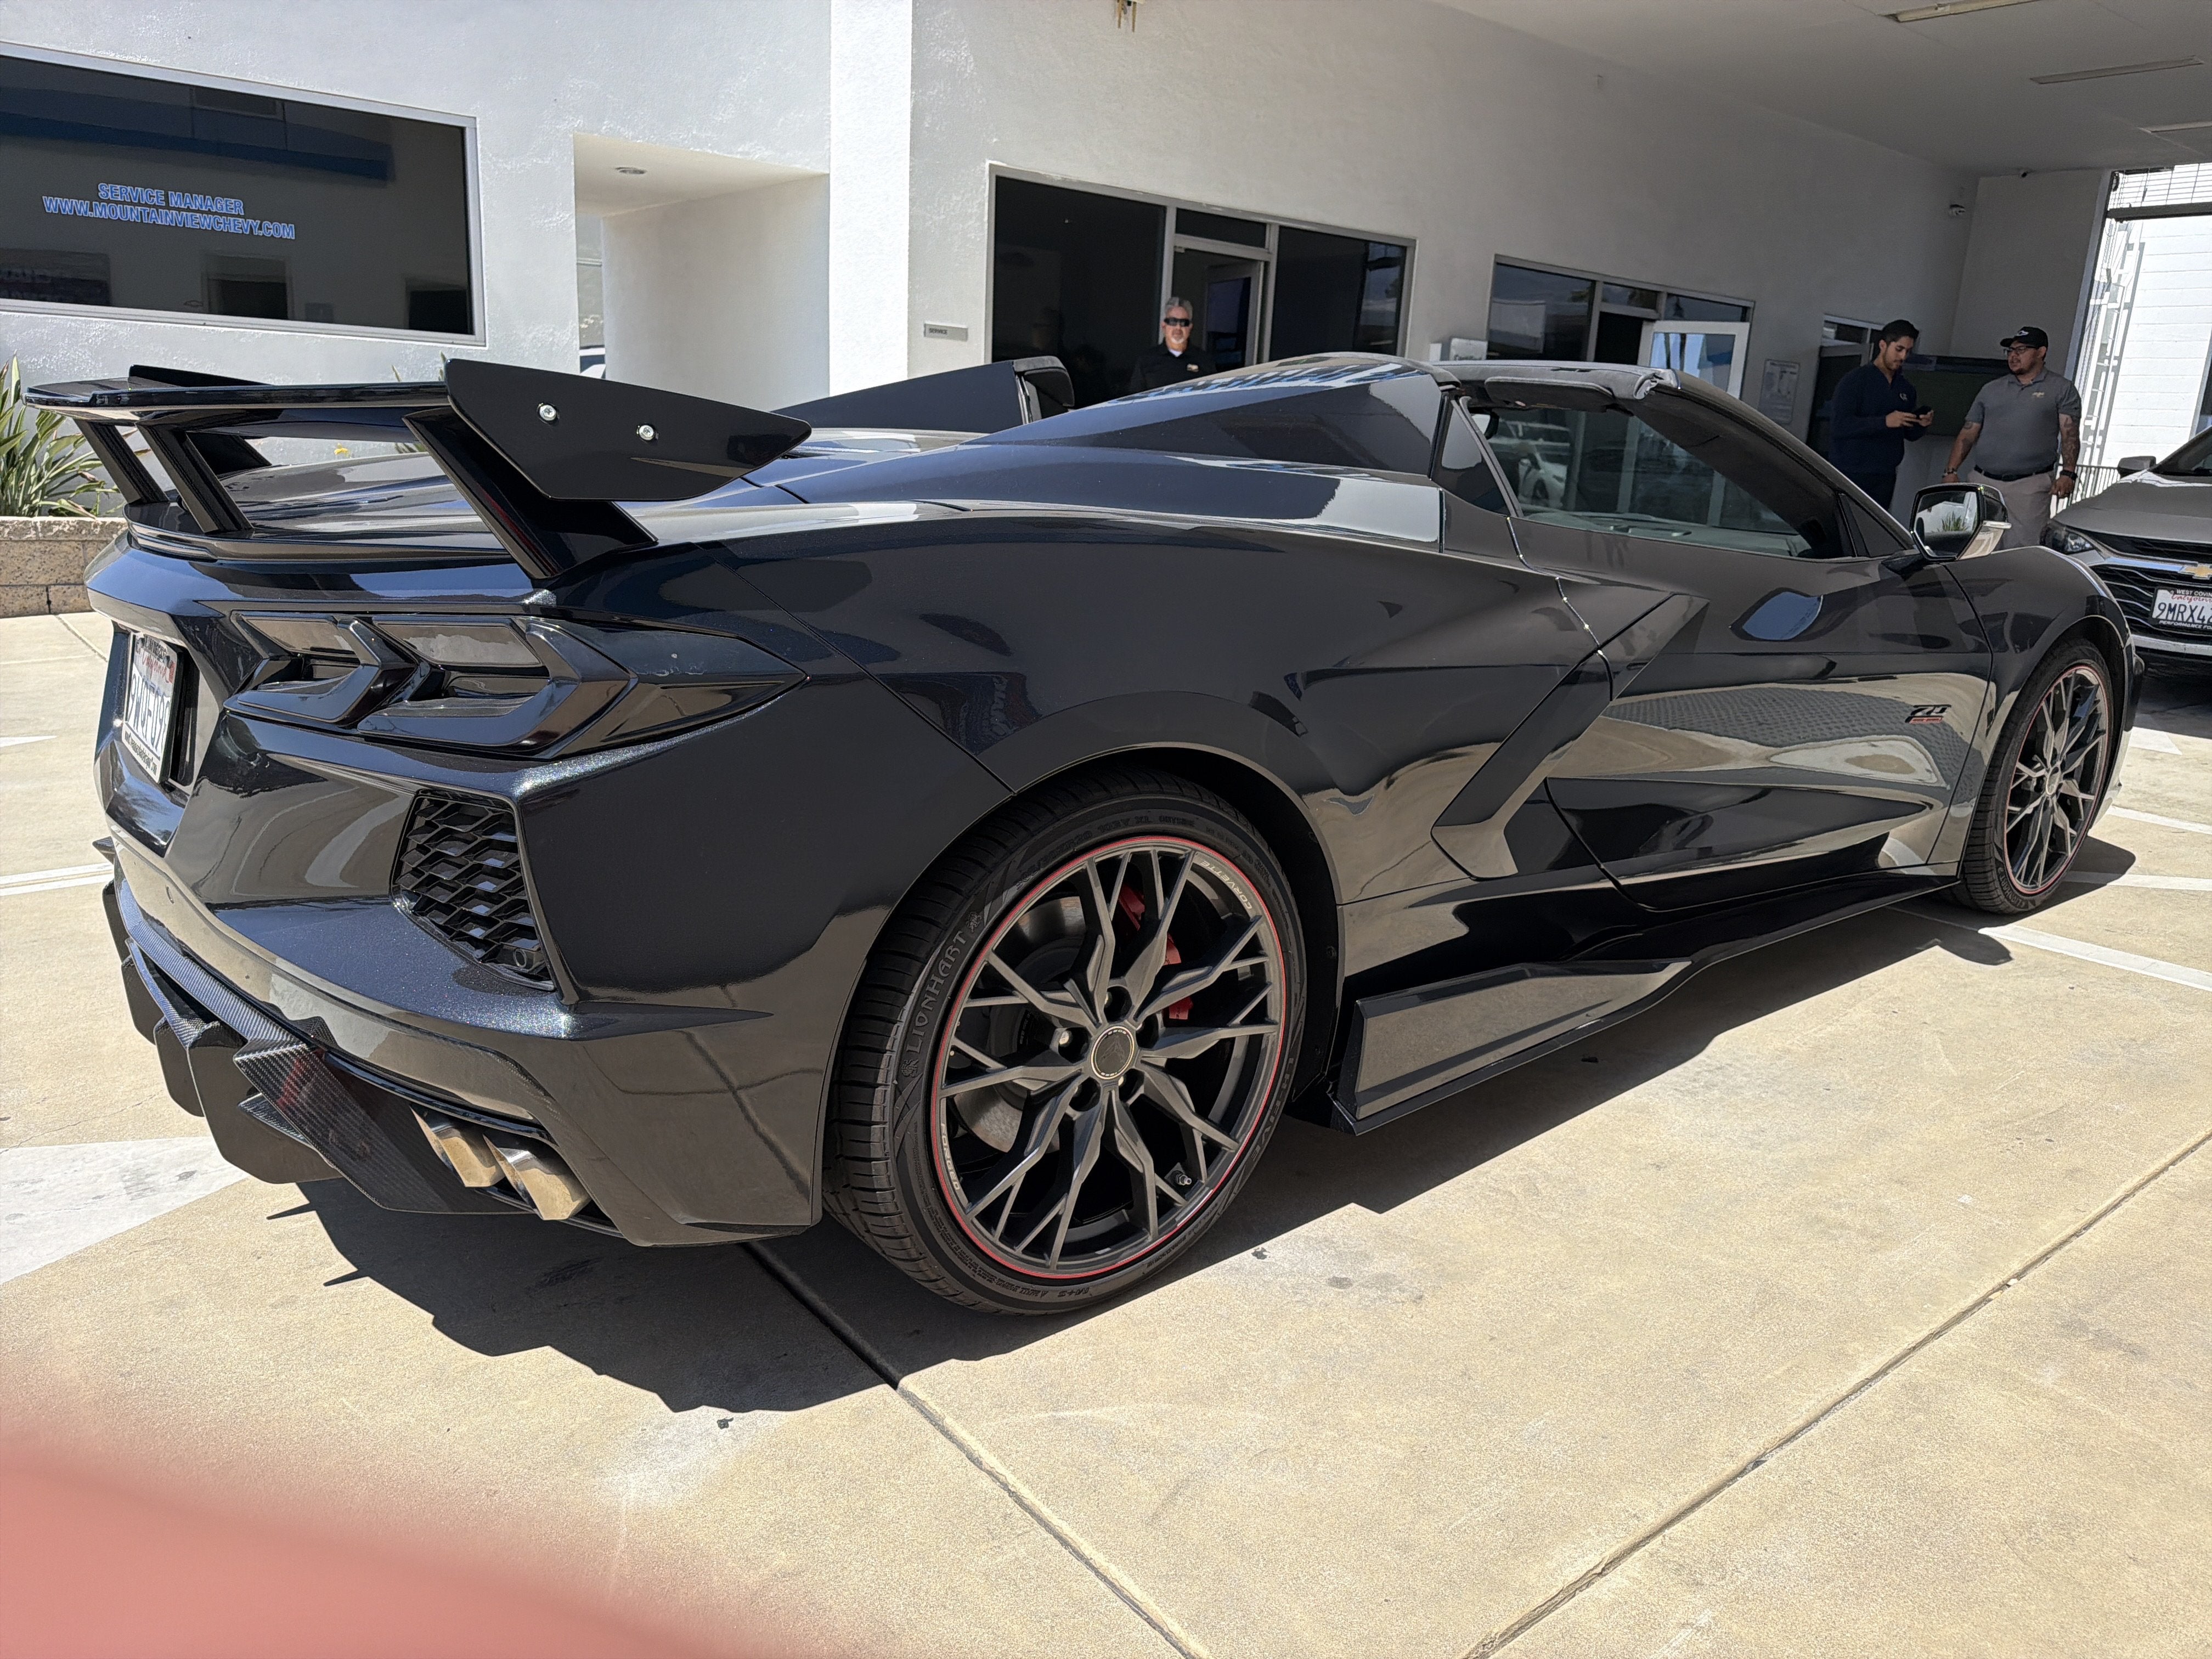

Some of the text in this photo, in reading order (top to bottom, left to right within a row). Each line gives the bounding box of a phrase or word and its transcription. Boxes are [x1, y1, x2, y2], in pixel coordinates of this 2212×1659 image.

[42, 196, 295, 239] WWW.MOUNTAINVIEWCHEVY.COM
[98, 183, 244, 215] SERVICE MANAGER
[2159, 620, 2202, 629] PERFORMANCE
[1199, 860, 1252, 910] CORVETTE
[2000, 875, 2025, 908] LIONHART
[906, 930, 967, 1054] LIONHART
[940, 1122, 960, 1190] FORGED
